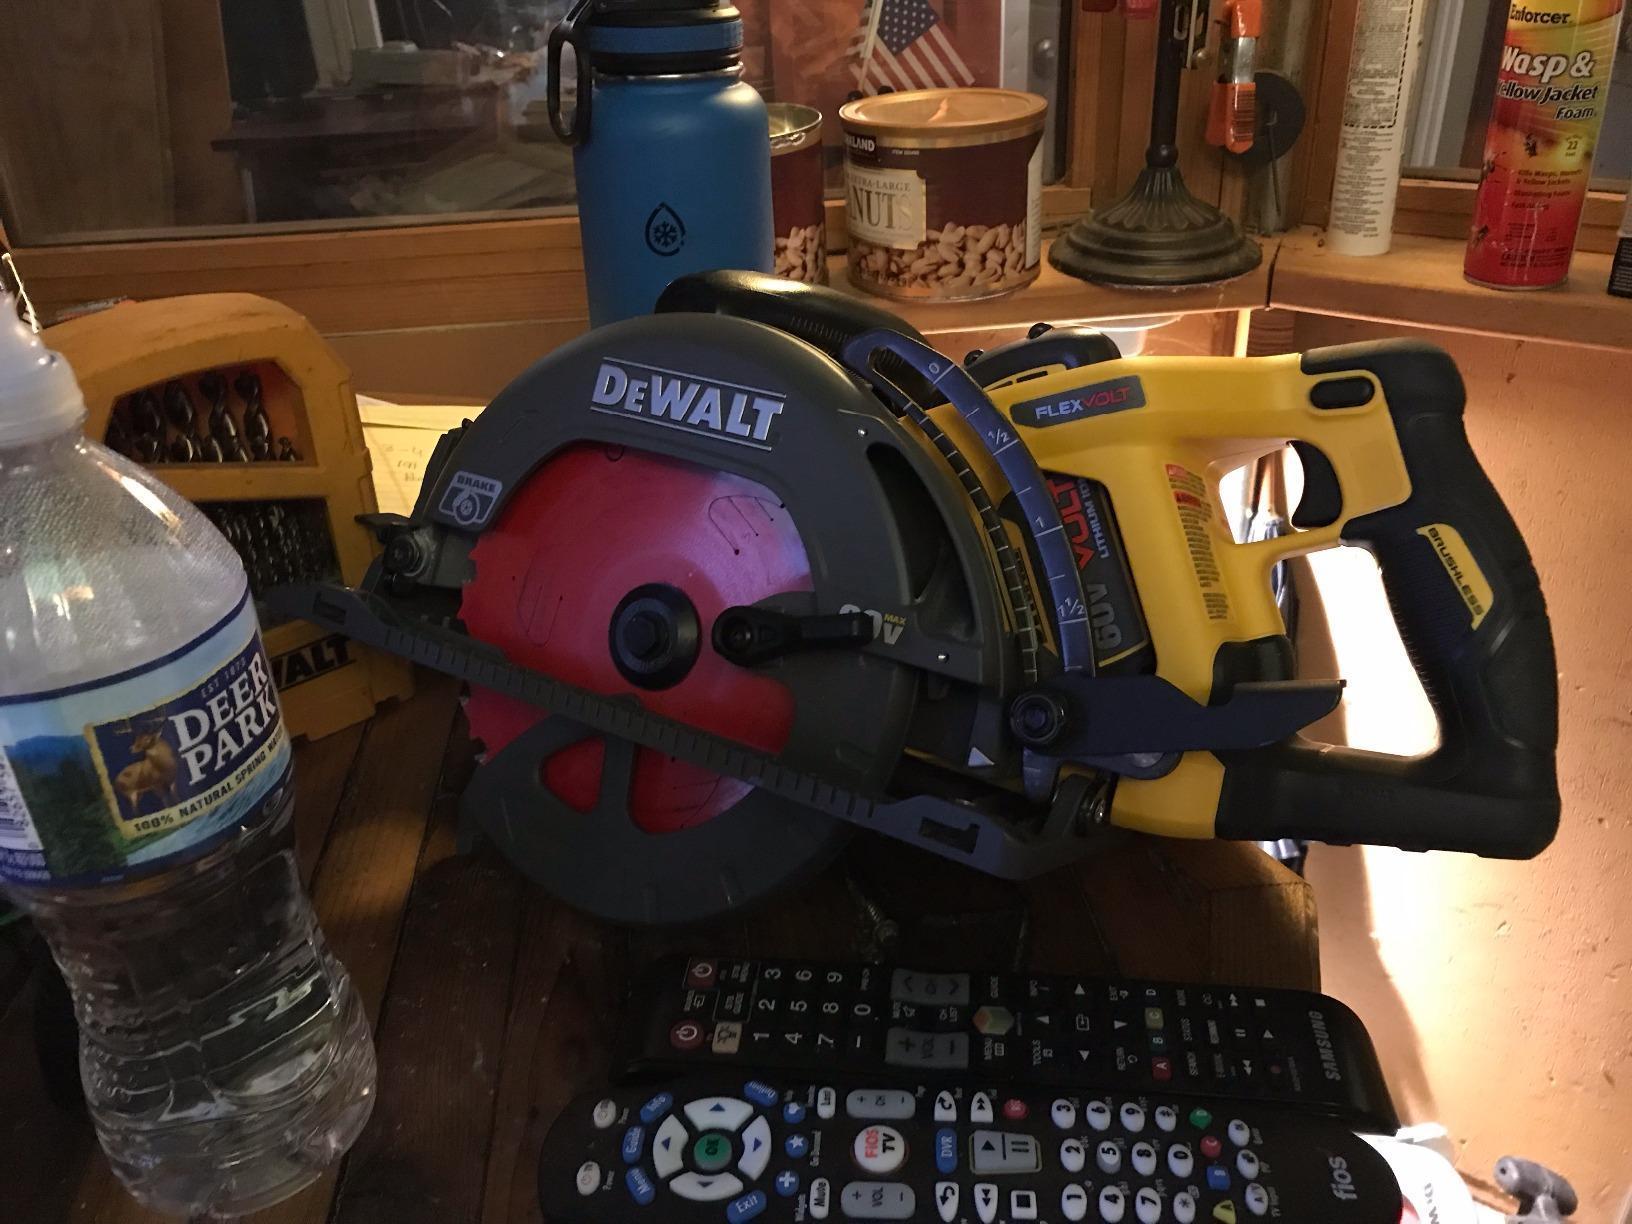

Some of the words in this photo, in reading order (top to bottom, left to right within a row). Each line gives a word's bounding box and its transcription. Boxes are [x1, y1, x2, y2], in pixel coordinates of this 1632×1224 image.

[1510, 4, 1570, 24] Enforcer
[1501, 45, 1568, 83] Wasp
[1570, 51, 1595, 78] &
[1539, 84, 1599, 104] Jacket
[1556, 107, 1593, 120] Foam
[456, 475, 497, 493] BRAKE
[1084, 500, 1110, 559] LITHIUM
[1428, 527, 1484, 616] BRUSHLESS
[884, 612, 906, 626] MAX
[1087, 583, 1122, 650] 60V
[201, 679, 220, 698] EST
[168, 652, 269, 752] DEER
[181, 682, 277, 785] PARK
[134, 815, 174, 832] 100%
[179, 782, 234, 818] NATURAL
[235, 750, 267, 784] SPRING
[764, 968, 781, 980] 3
[795, 970, 812, 981] 6
[827, 971, 843, 983] 9
[759, 999, 776, 1010] 2
[790, 1000, 807, 1012] 5
[822, 1002, 839, 1014] 8
[854, 1003, 871, 1016] 0
[753, 1032, 770, 1041] 1
[785, 1032, 802, 1044] 4
[817, 1033, 834, 1048] 7
[1032, 1039, 1041, 1066] TOOLS
[1308, 1010, 1341, 1081] SAMSUNG
[1156, 1062, 1168, 1070] A
[1056, 1104, 1071, 1112] 3
[705, 1139, 720, 1156] OK
[882, 1133, 895, 1153] TV
[941, 1136, 953, 1158] DVR
[1065, 1146, 1080, 1154] 2
[1101, 1147, 1117, 1155] 5
[1136, 1149, 1152, 1158] 8
[631, 1168, 650, 1194] Menu
[1328, 1156, 1358, 1200] fios
[814, 1182, 827, 1207] Mute
[872, 1187, 884, 1207] VOL
[1104, 1193, 1120, 1204] 4
[1141, 1195, 1157, 1205] 7
[735, 1195, 759, 1214] Exit
